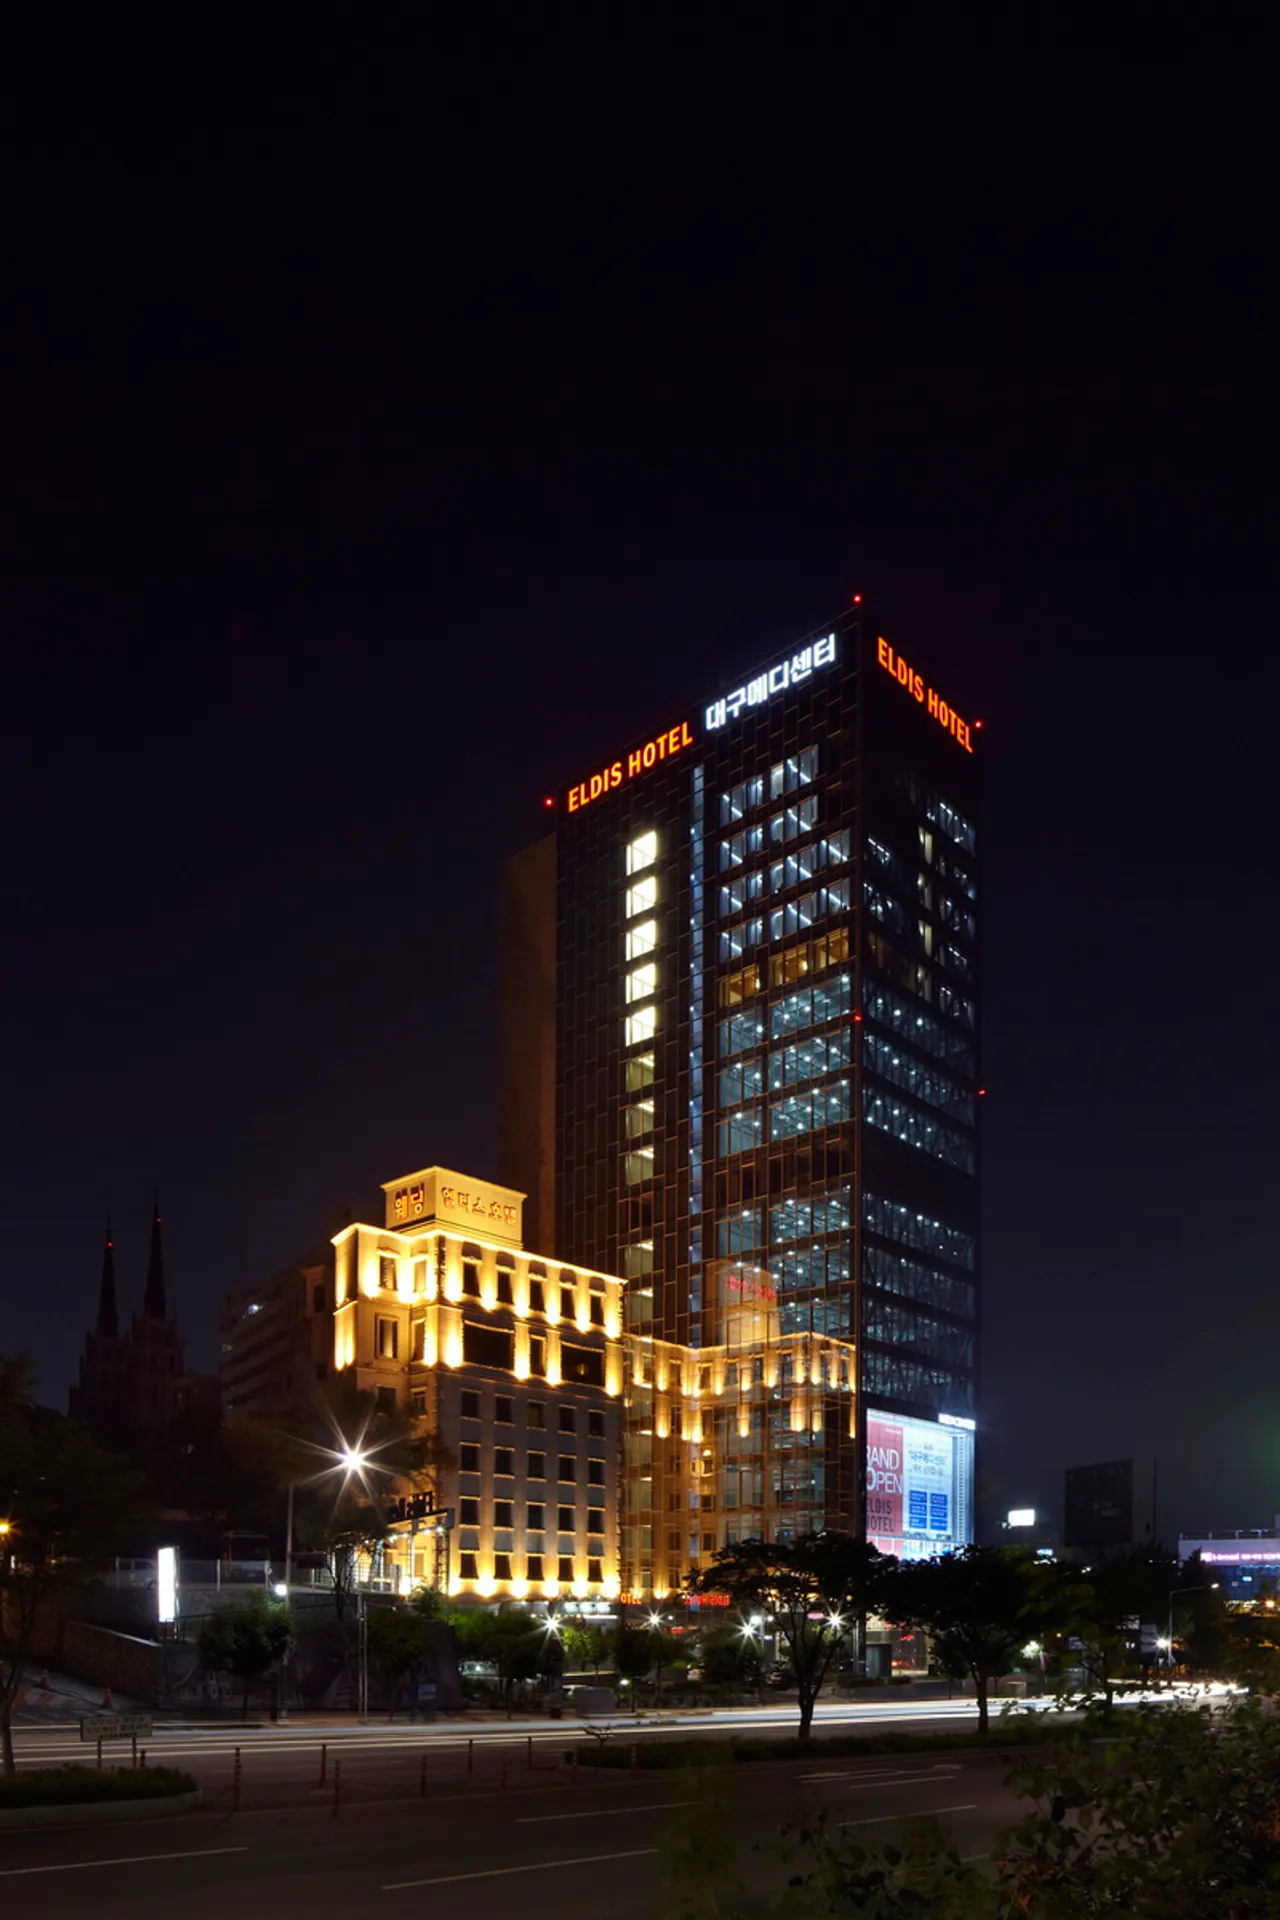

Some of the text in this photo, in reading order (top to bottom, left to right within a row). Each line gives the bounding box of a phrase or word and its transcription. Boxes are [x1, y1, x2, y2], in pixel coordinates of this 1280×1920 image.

[705, 633, 836, 731] 대구메디센터
[877, 636, 974, 754] ELDIS HOTEL
[567, 720, 693, 812] ELDIS HOTEL
